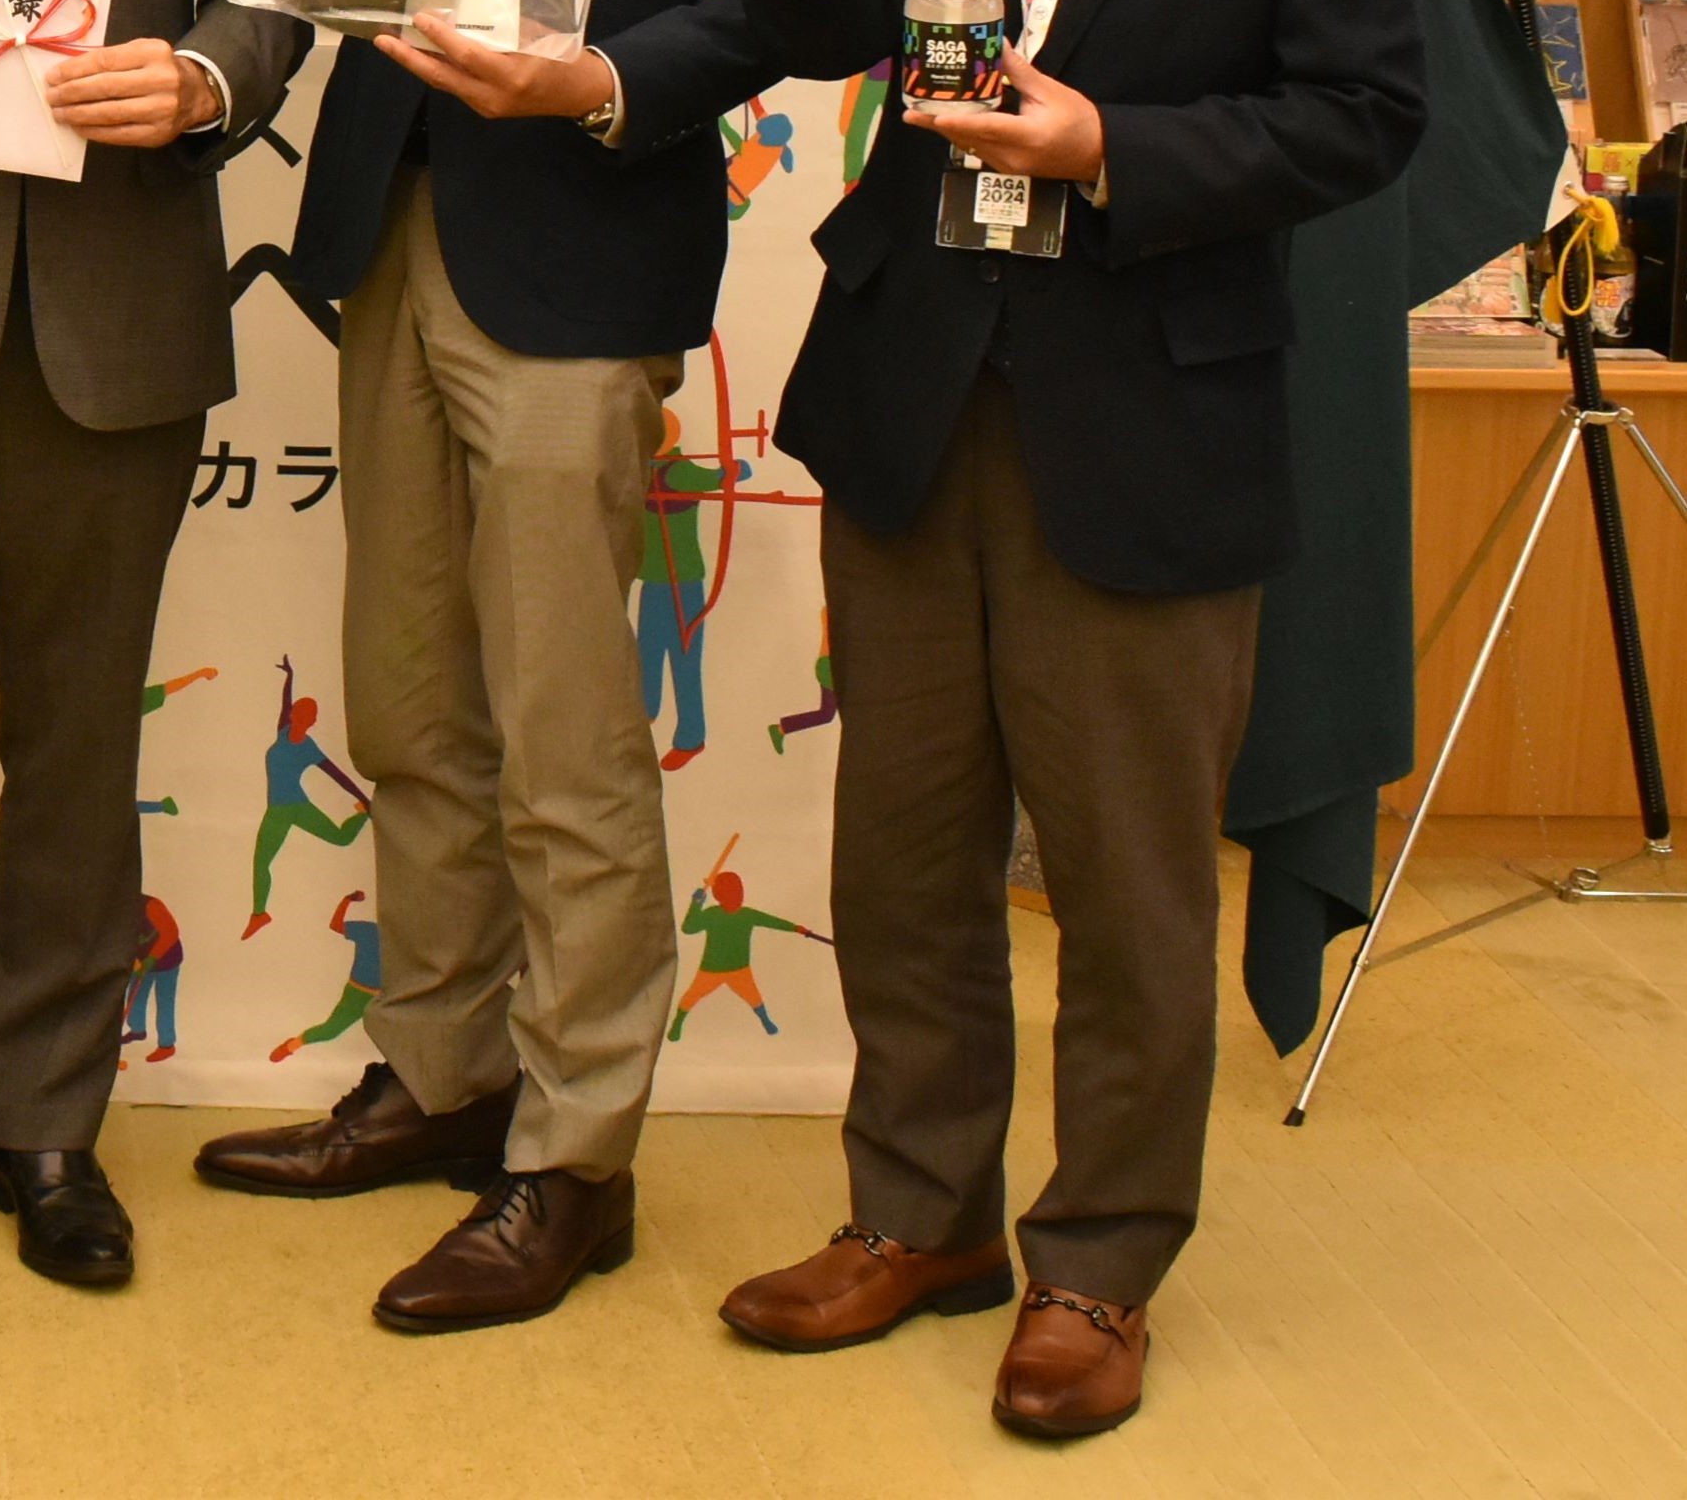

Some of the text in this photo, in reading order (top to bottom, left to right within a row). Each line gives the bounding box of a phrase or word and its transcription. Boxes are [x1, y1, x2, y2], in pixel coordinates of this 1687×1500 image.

[926, 39, 967, 52] SAGA
[925, 50, 967, 65] 2024
[981, 176, 1026, 191] SAGA
[980, 188, 1025, 204] 2024
